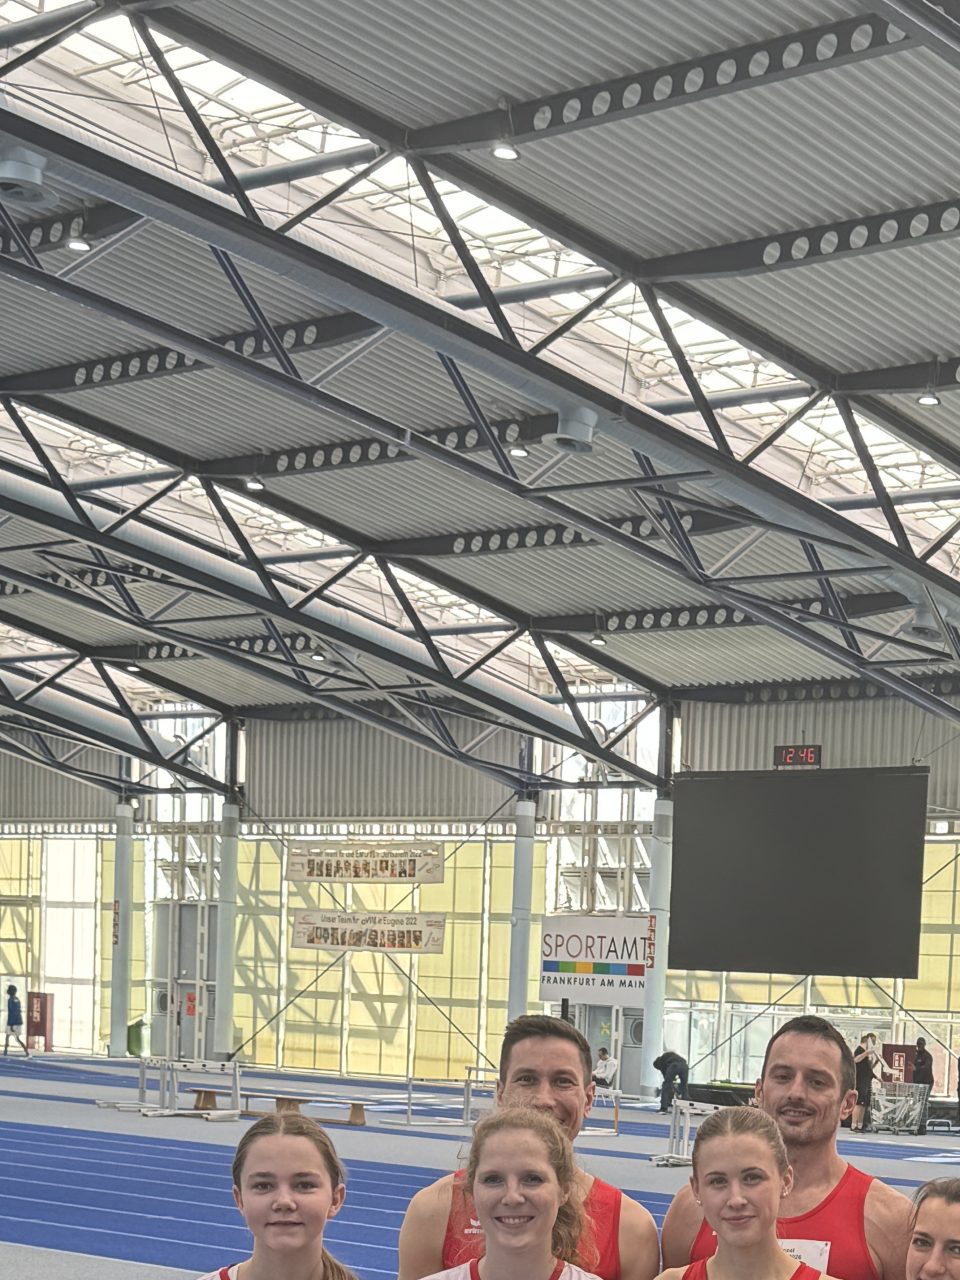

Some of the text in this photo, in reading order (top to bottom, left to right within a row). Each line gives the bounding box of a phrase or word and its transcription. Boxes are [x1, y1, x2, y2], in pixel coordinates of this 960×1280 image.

[542, 933, 649, 960] SPORTAMT
[541, 976, 645, 988] FRANKFURT AM MAIN
